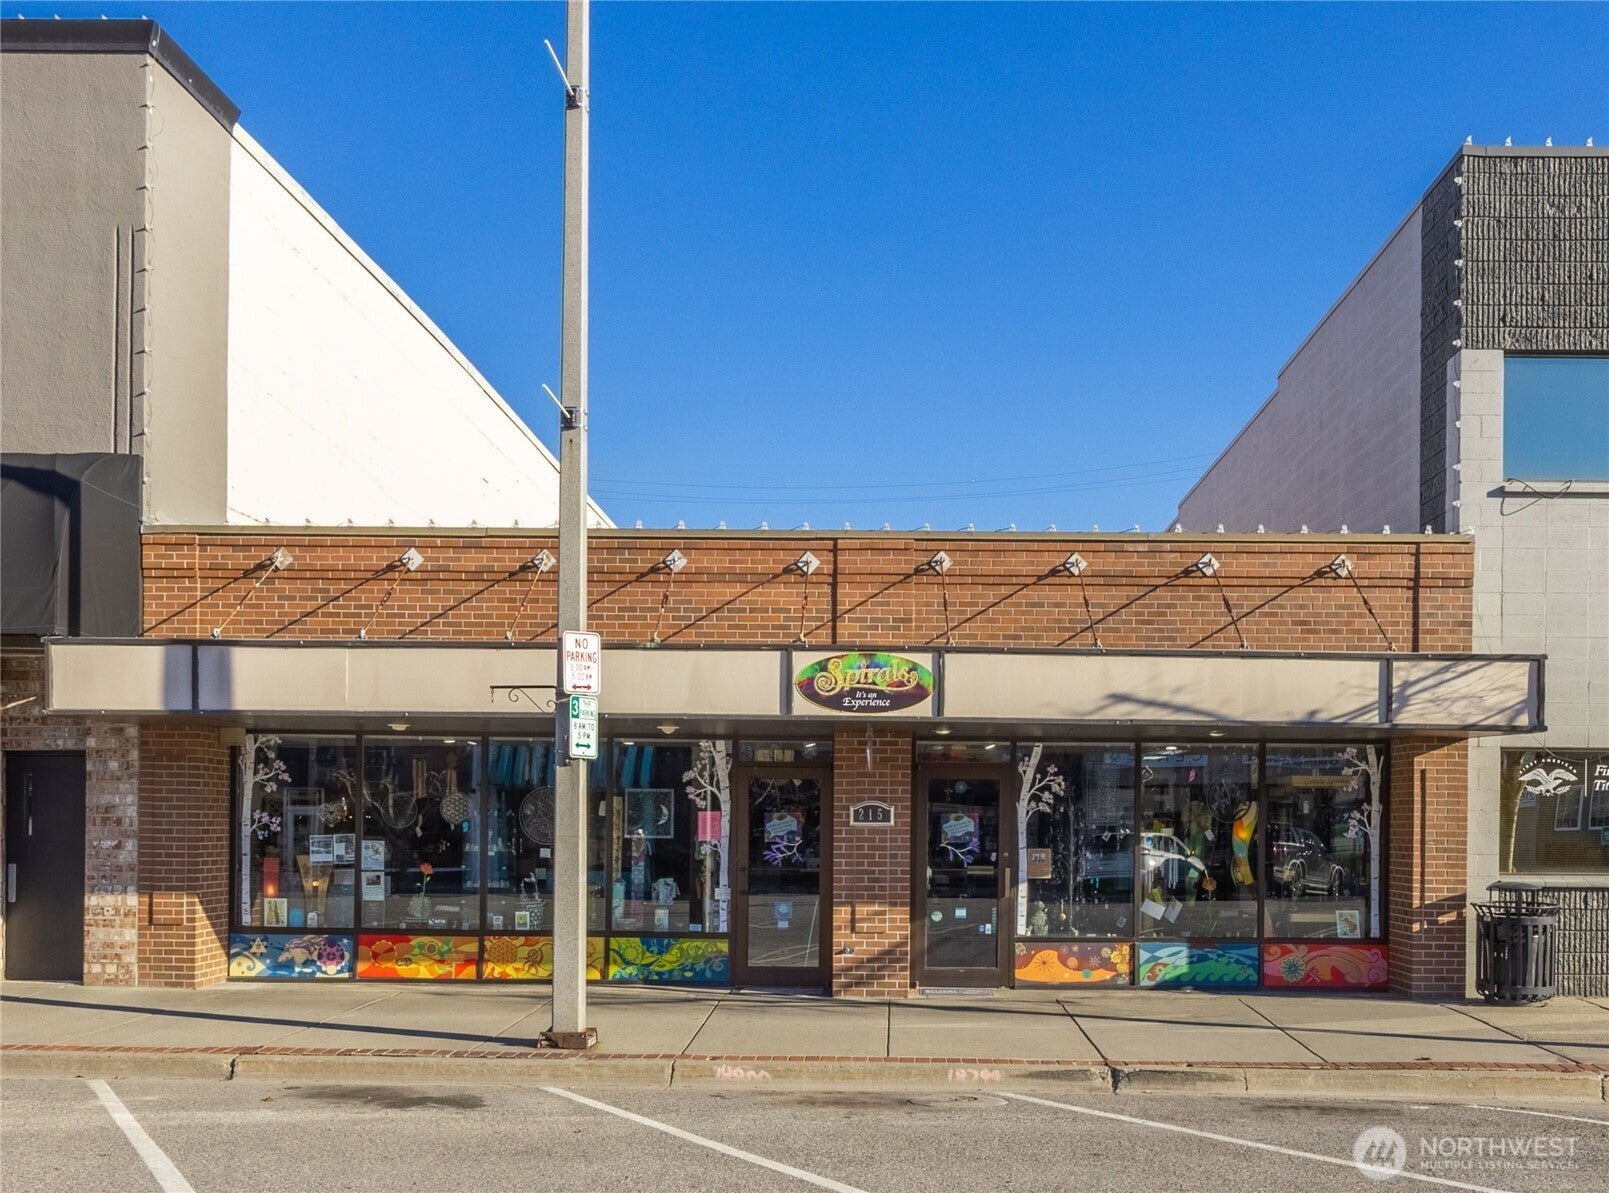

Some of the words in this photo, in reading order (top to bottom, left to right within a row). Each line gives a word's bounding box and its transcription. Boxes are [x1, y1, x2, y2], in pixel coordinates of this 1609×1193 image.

[574, 638, 589, 650] NO
[566, 650, 598, 664] PARKING
[813, 658, 919, 696] Spirals
[572, 699, 579, 715] 3
[842, 698, 891, 711] Experience
[578, 722, 586, 730] AM
[588, 723, 595, 731] TO
[583, 732, 591, 740] PM
[858, 808, 883, 821] 215
